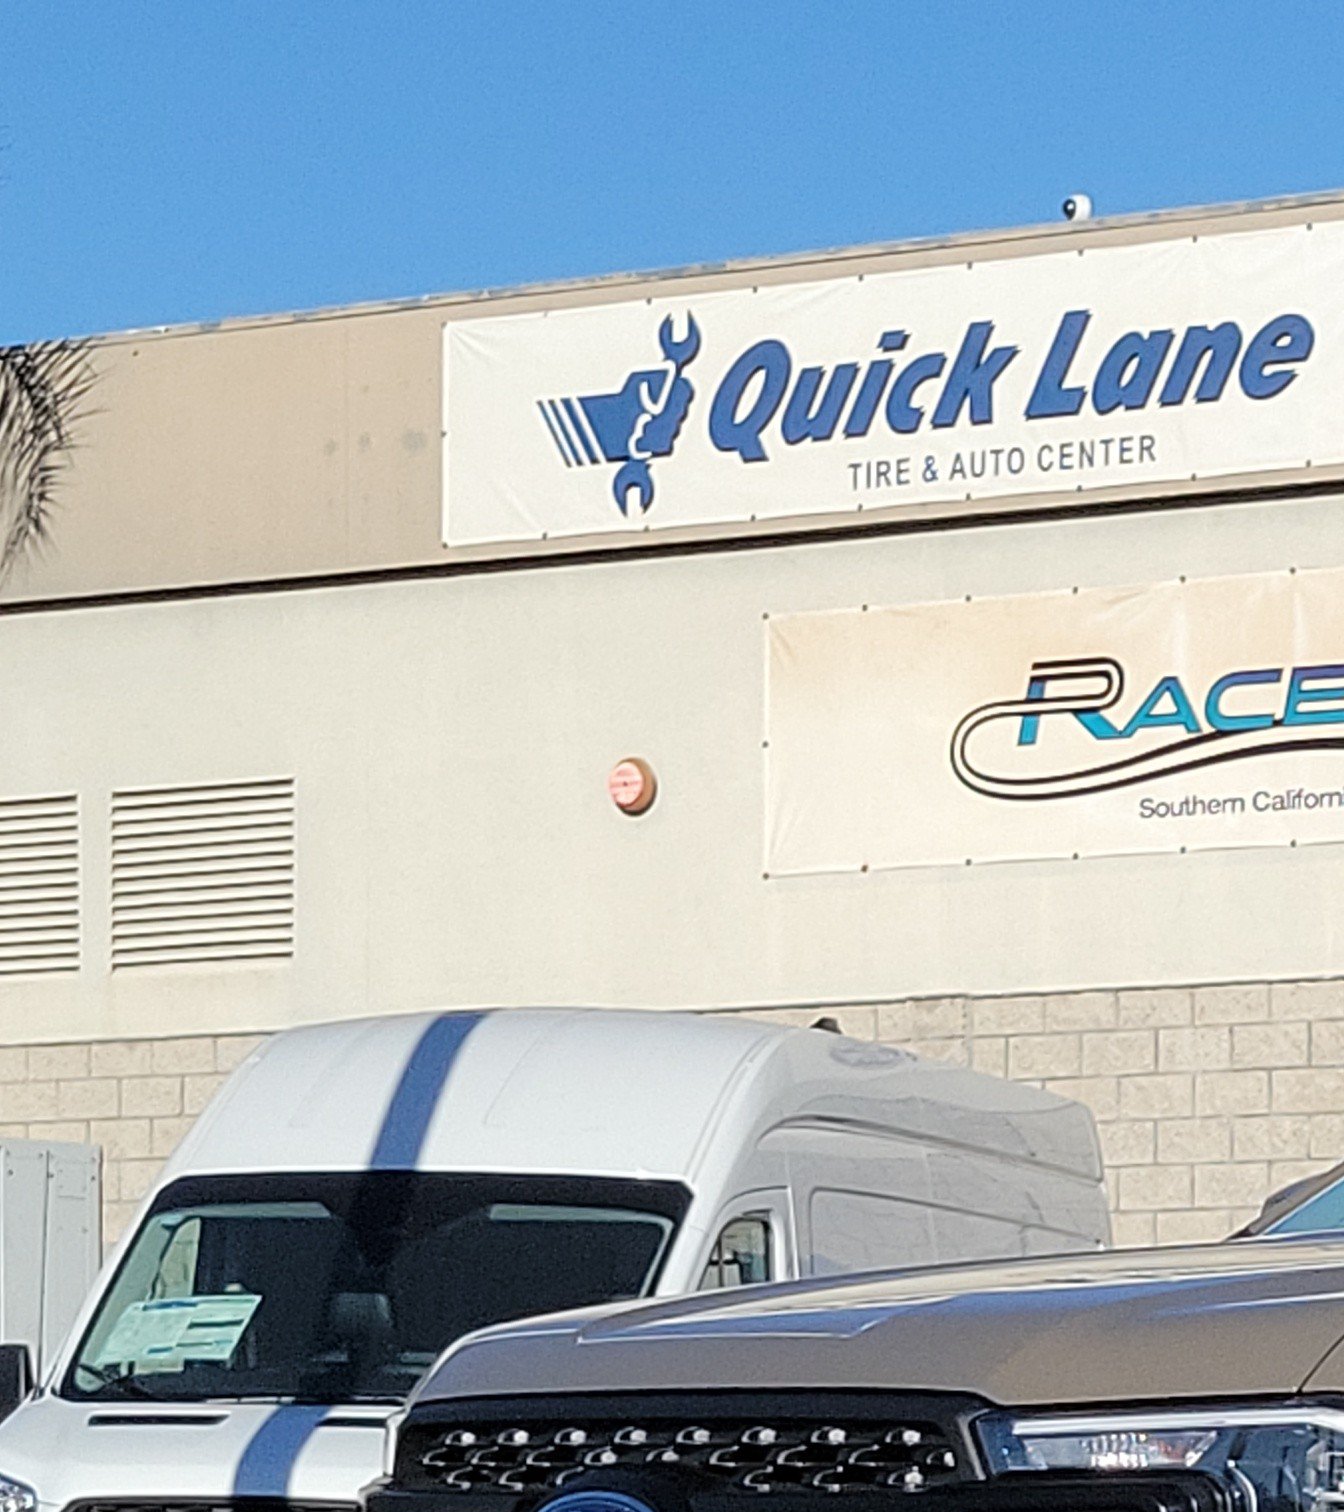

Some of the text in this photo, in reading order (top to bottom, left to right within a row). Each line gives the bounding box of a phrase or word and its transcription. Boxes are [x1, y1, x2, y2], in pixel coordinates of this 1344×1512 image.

[707, 309, 1316, 461] Quick Lane
[847, 435, 1157, 490] TIRE & AUTO CENTER
[1139, 796, 1246, 820] Southern
